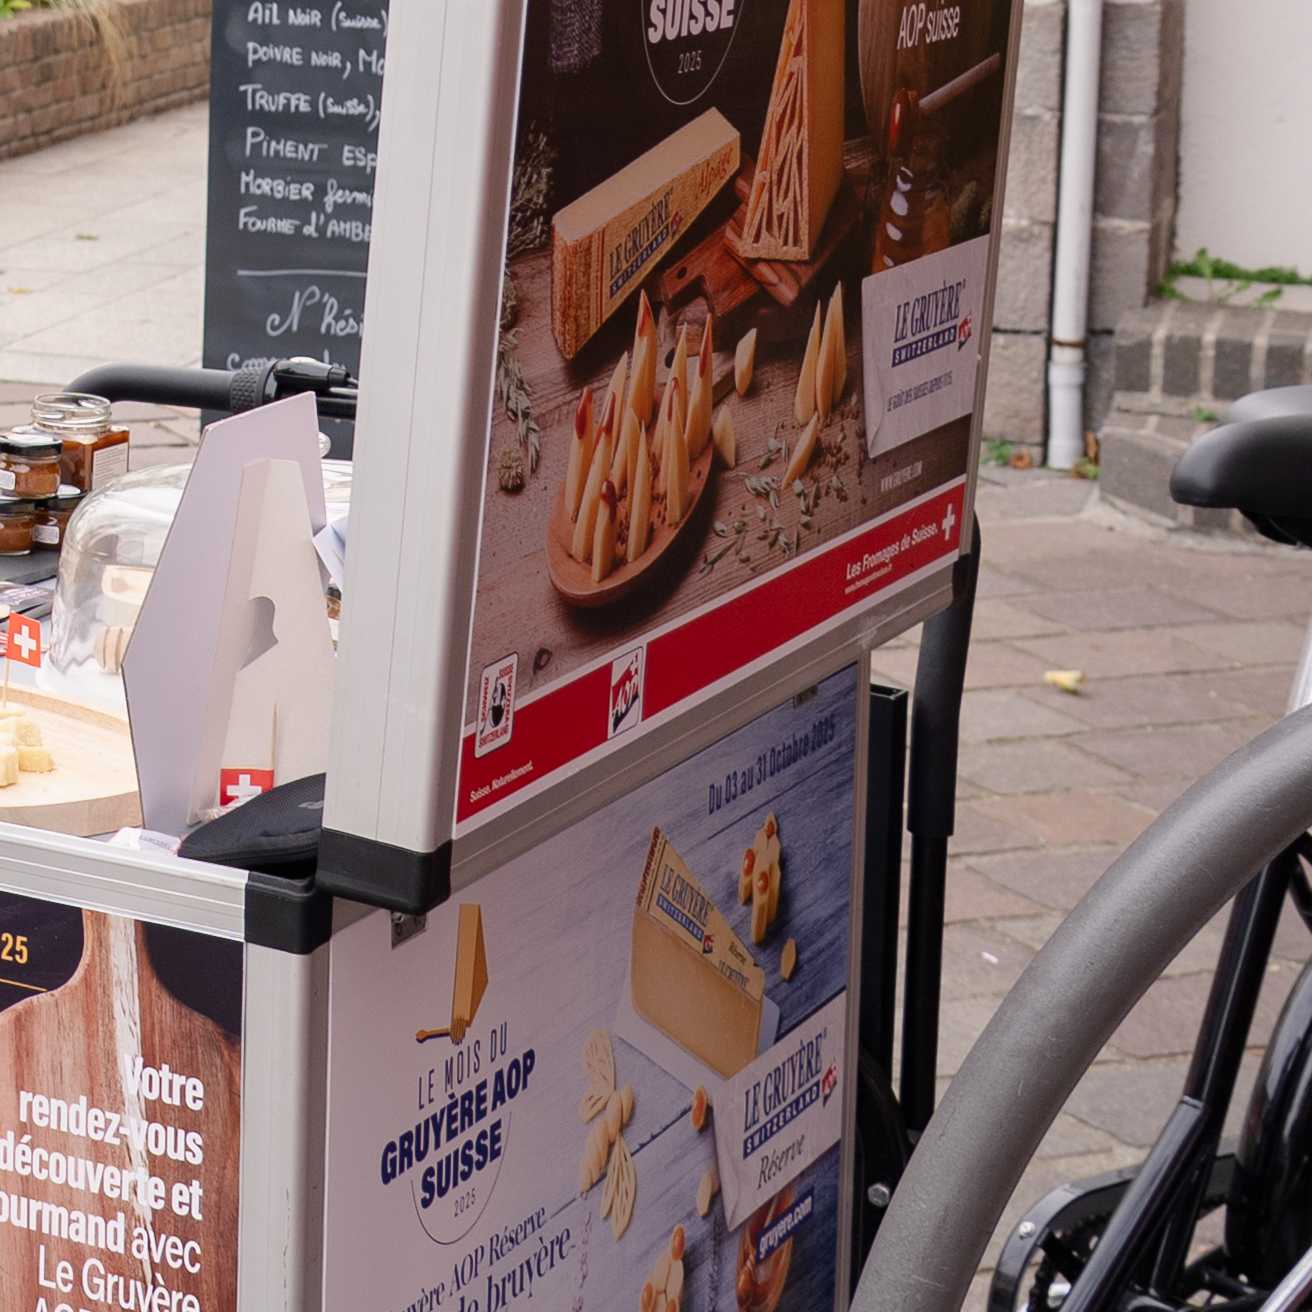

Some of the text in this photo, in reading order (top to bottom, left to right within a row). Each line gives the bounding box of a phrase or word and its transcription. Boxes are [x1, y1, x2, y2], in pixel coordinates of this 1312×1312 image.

[897, 2, 926, 50] AOP
[677, 50, 703, 74] 2025
[609, 191, 671, 281] LE GRUYÈRE
[266, 285, 363, 337] N'hési
[894, 301, 910, 343] LE
[910, 280, 962, 337] GRUYÈRE
[894, 328, 956, 365] SWITZERLAND
[846, 562, 861, 580] Les
[862, 541, 900, 571] Fromages
[901, 533, 911, 551] de
[911, 522, 938, 545] Suisse.
[709, 783, 722, 816] Du
[725, 770, 738, 804] 03
[740, 767, 754, 795] au
[756, 753, 767, 785] 31
[769, 733, 809, 777] Octobre
[660, 863, 674, 894] LE
[671, 874, 713, 927] GRUYÈRE
[124, 1054, 204, 1111] Votre
[419, 1021, 508, 1110] LE MOIS DU
[744, 1033, 823, 1133] LE GRUYÈRE
[19, 1090, 204, 1165] rendez-vous
[381, 1049, 536, 1185] GRUYÈRE AOP
[745, 1086, 819, 1154] SWITZERLAND
[421, 1118, 502, 1209] SUISSE
[757, 1134, 805, 1190] Réserve
[171, 1179, 204, 1221] et
[454, 1187, 478, 1218] 2025
[759, 1195, 813, 1260] gruyere.com
[38, 1244, 201, 1312] Le Gruyère
[131, 1225, 202, 1274] avec
[450, 1207, 546, 1296] AOP Réserve
